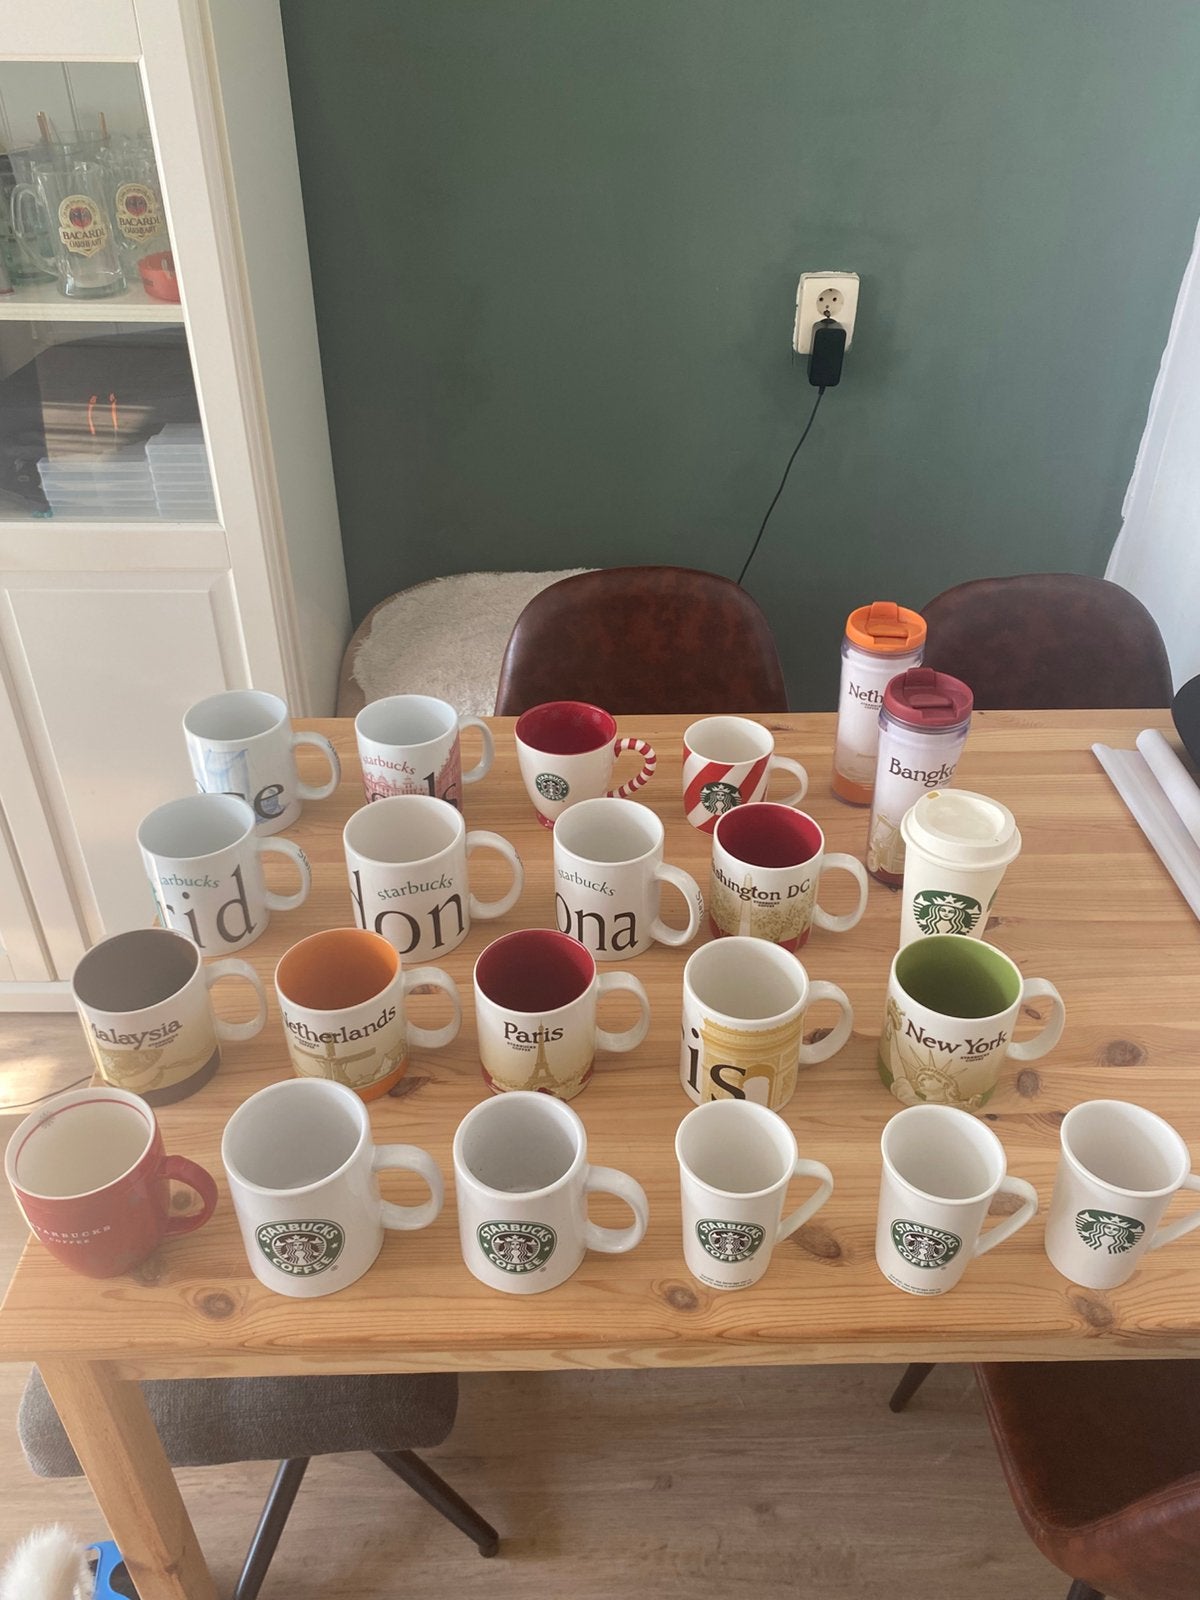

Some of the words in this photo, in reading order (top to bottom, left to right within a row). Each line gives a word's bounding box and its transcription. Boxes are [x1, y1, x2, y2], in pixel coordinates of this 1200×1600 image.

[119, 216, 160, 226] BACARDI
[62, 228, 105, 240] BACARDI
[159, 873, 221, 889] arbucks
[377, 873, 454, 901] starbucks
[711, 862, 781, 902] shington
[786, 878, 811, 899] DC
[503, 1020, 564, 1044] Paris
[904, 1018, 962, 1054] New
[964, 1030, 1009, 1055] York
[682, 1025, 747, 1101] is
[258, 1222, 338, 1244] STARBUCKS
[480, 1222, 552, 1243] STARBUCKS
[699, 1221, 763, 1240] STARBUCKS
[895, 1222, 959, 1249] STARBUCKS
[488, 1253, 544, 1272] COFFEE
[705, 1244, 753, 1262] COFFEE
[897, 1244, 946, 1268] COFFEE
[272, 1255, 334, 1275] COFFEE
